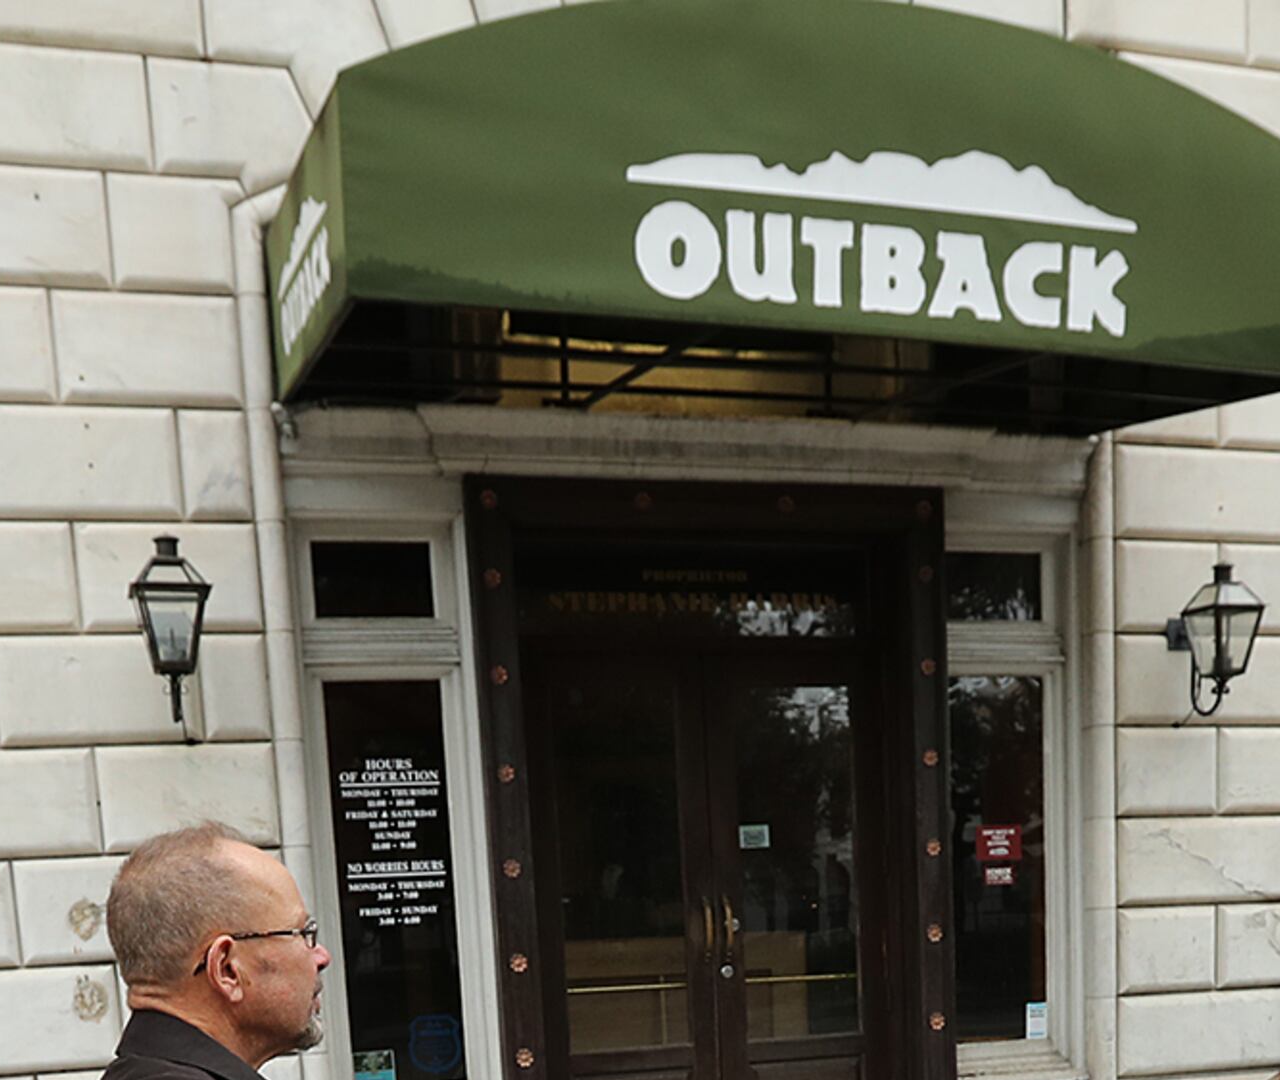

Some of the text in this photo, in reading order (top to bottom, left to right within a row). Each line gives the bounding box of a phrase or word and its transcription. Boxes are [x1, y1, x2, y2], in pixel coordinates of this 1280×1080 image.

[635, 200, 1129, 337] OUTBACK
[365, 758, 412, 770] HOURS
[339, 769, 439, 782] OF OPERATION
[341, 788, 381, 798] MONDAY
[390, 788, 439, 797] THURSDAY
[345, 810, 379, 820] FRIDAY
[391, 809, 437, 819] SATURDAY
[374, 831, 411, 840] SUNDAY
[347, 860, 445, 873] NO WORRIES HOURS
[348, 882, 388, 891] MONDAY
[397, 880, 445, 890] THURSDAY
[359, 907, 392, 916] FRIDAY
[401, 905, 438, 914] SUNDAY
